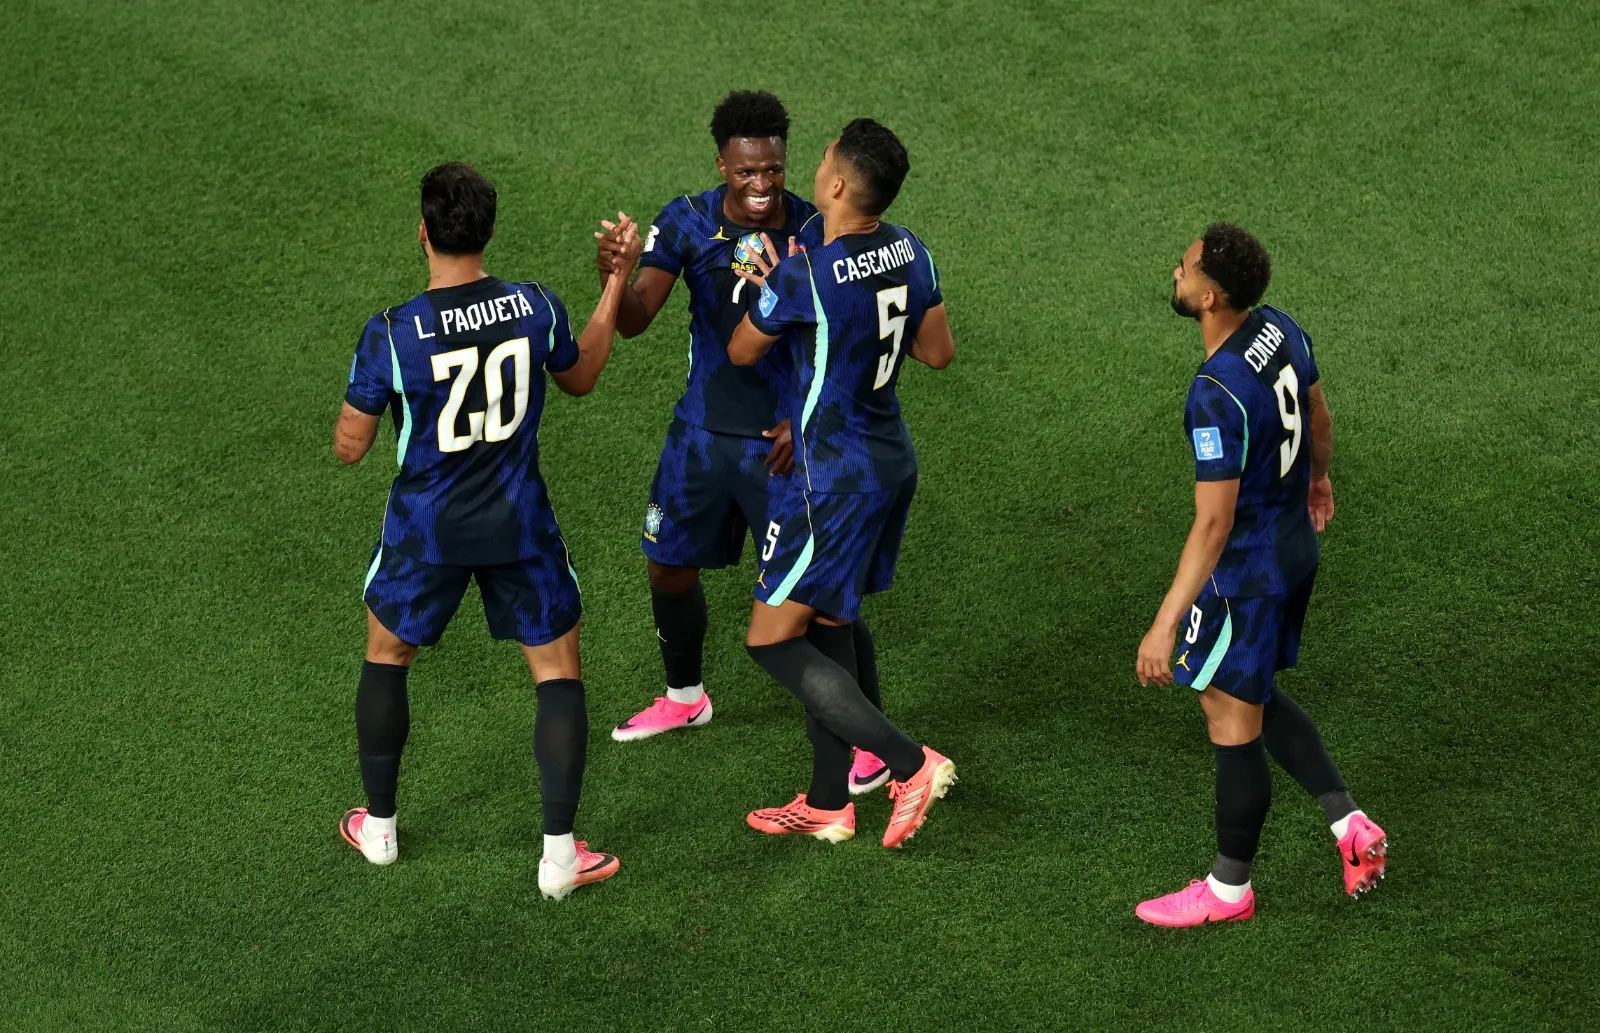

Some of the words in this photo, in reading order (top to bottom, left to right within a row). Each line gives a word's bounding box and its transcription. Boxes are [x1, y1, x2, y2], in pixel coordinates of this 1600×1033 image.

[731, 262, 758, 271] BRASIL
[832, 237, 915, 284] CASEMIRO
[414, 315, 436, 340] L.
[440, 290, 534, 335] PAQUETÁ
[873, 285, 910, 391] 5
[1244, 322, 1285, 374] CUNHA
[430, 336, 531, 453] 20
[1272, 363, 1302, 479] 9
[761, 520, 781, 562] 5
[1185, 603, 1203, 645] 9
